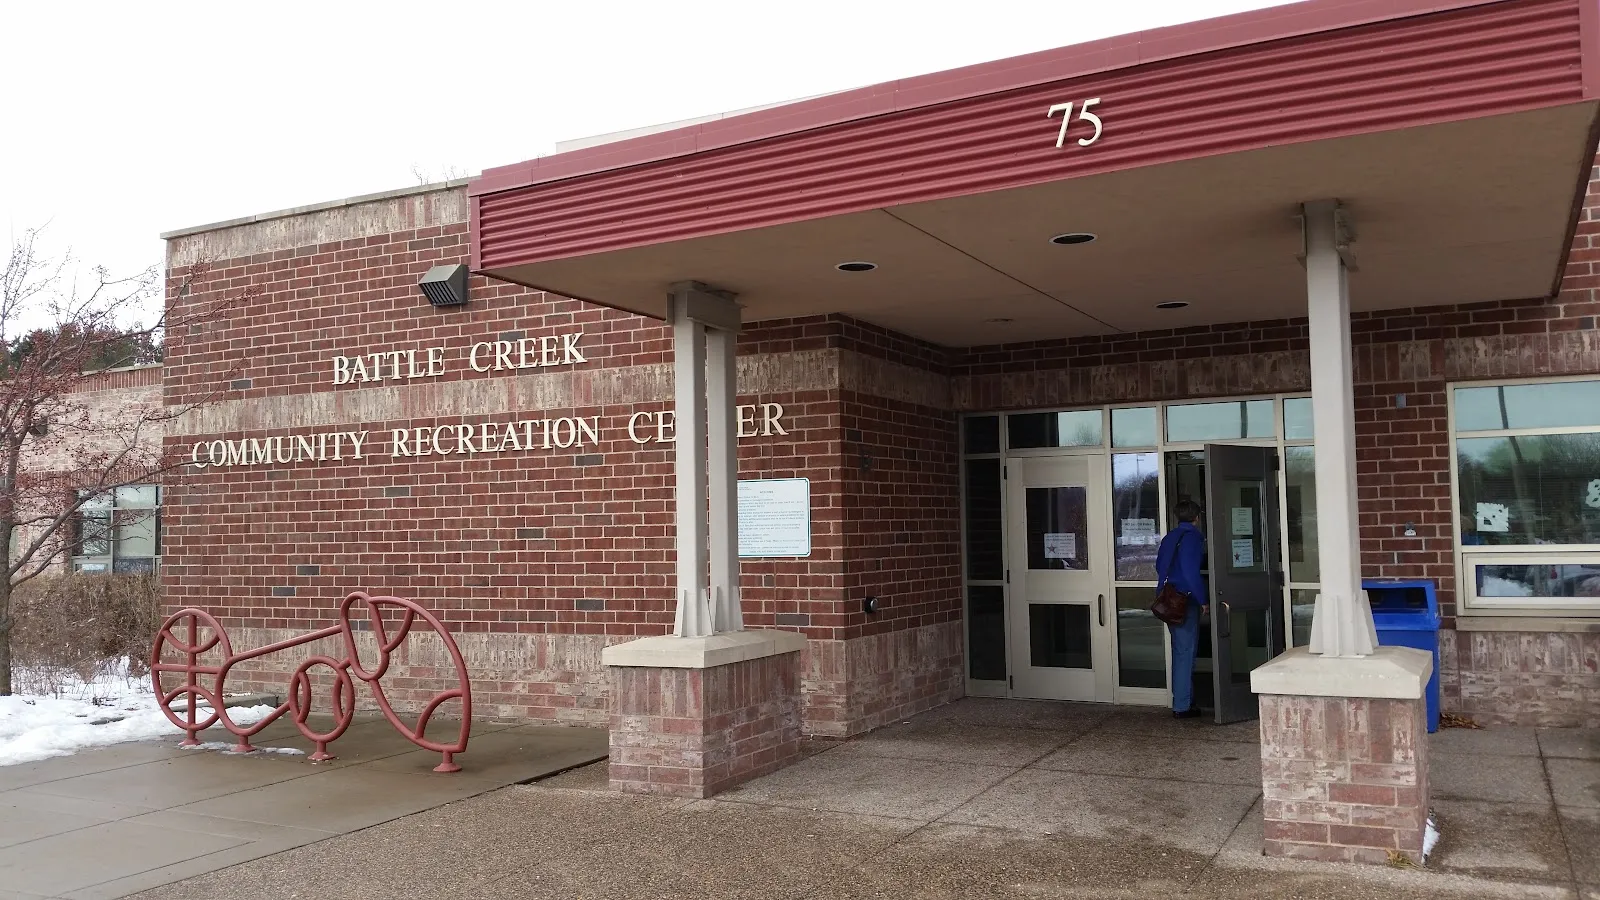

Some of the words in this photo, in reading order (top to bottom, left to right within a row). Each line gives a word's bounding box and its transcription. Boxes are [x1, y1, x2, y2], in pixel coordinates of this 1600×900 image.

[1047, 97, 1103, 148] 75
[331, 346, 446, 386] BATTLE
[469, 332, 588, 373] CREEK
[192, 430, 369, 468] COMMUNITY
[391, 415, 601, 457] RECREATION
[628, 402, 789, 444] CEER
